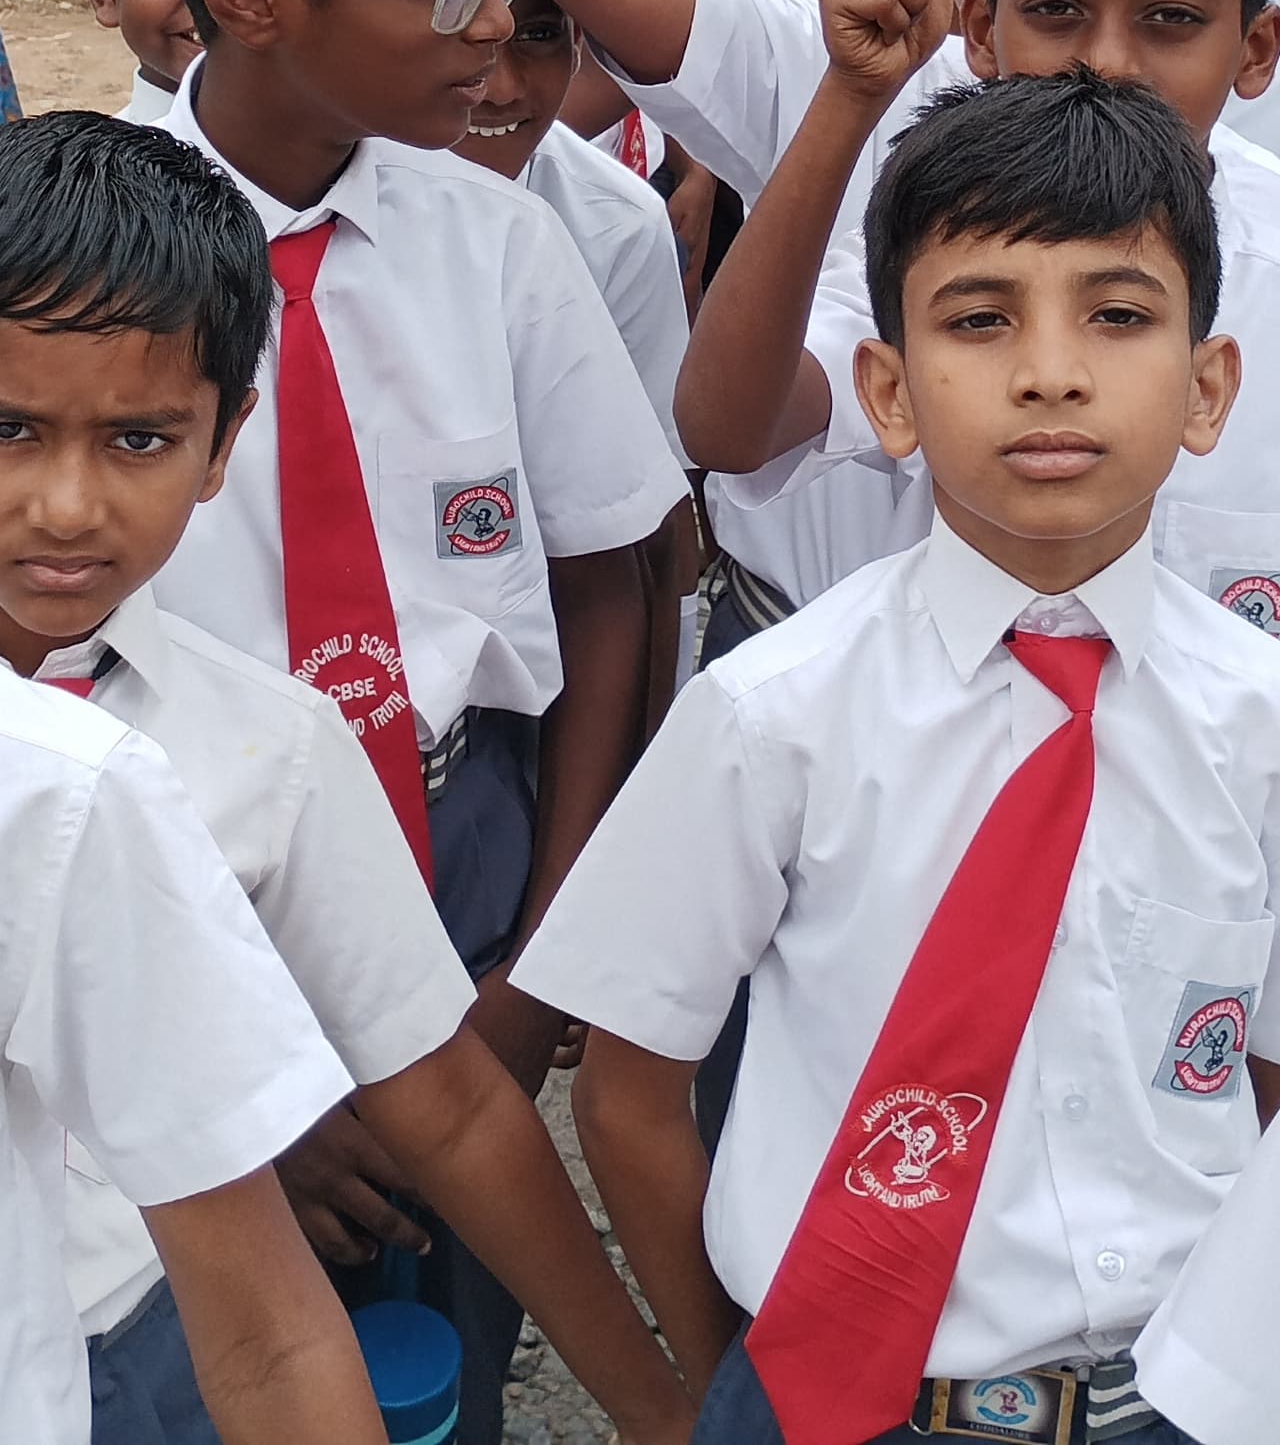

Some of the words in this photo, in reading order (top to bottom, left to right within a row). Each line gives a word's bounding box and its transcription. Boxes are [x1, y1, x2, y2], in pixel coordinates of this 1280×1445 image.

[294, 634, 352, 683] ROCHILD
[359, 633, 404, 681] SCHOOL
[328, 677, 377, 703] CBSE
[349, 718, 365, 736] ND
[369, 690, 409, 730] TRUTH
[861, 1088, 936, 1133] AUROCHILD
[935, 1099, 967, 1155] SCHOOL
